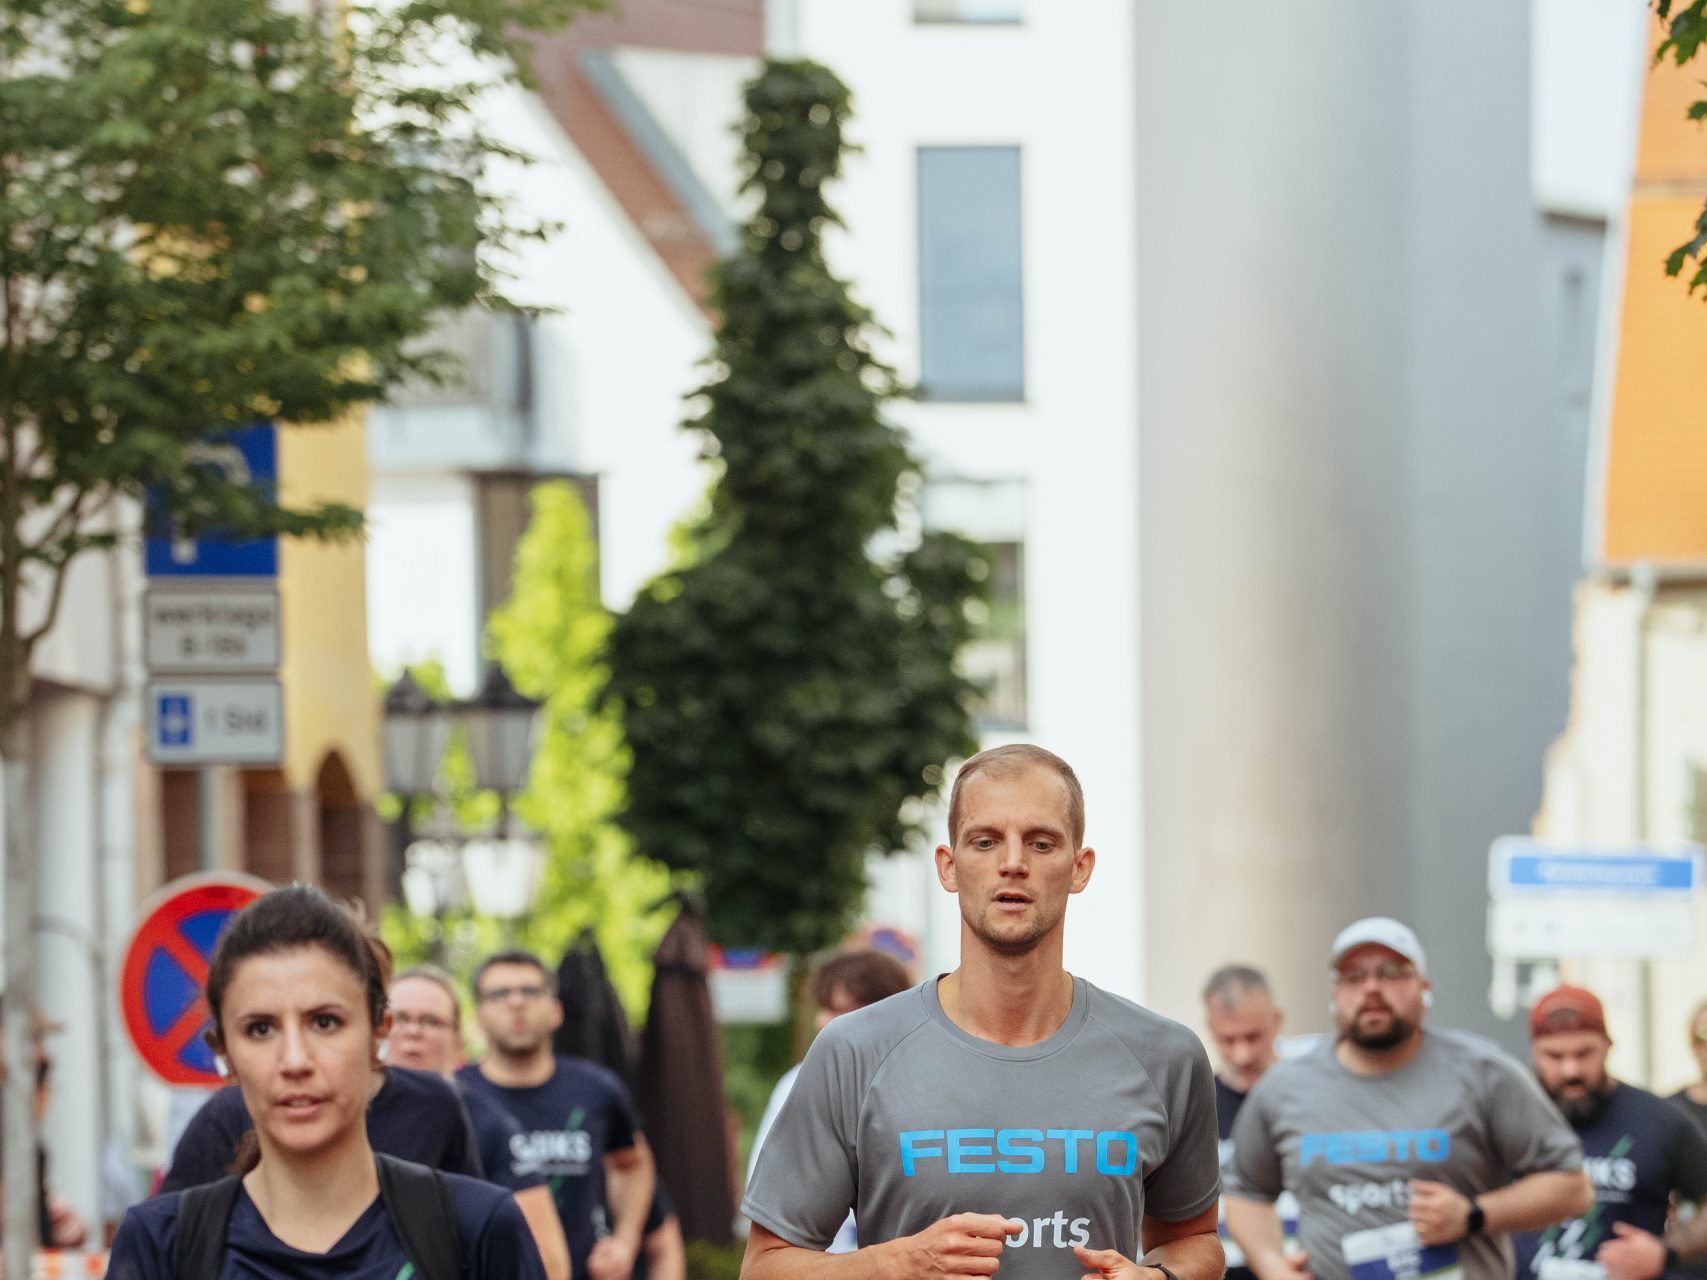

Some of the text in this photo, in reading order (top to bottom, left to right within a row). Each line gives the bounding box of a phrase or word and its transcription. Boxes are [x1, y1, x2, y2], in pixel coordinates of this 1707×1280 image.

[899, 1128, 1138, 1177] FESTO
[1302, 1128, 1449, 1165] FESTO
[1328, 1179, 1410, 1214] sport
[1005, 1210, 1091, 1248] orts
